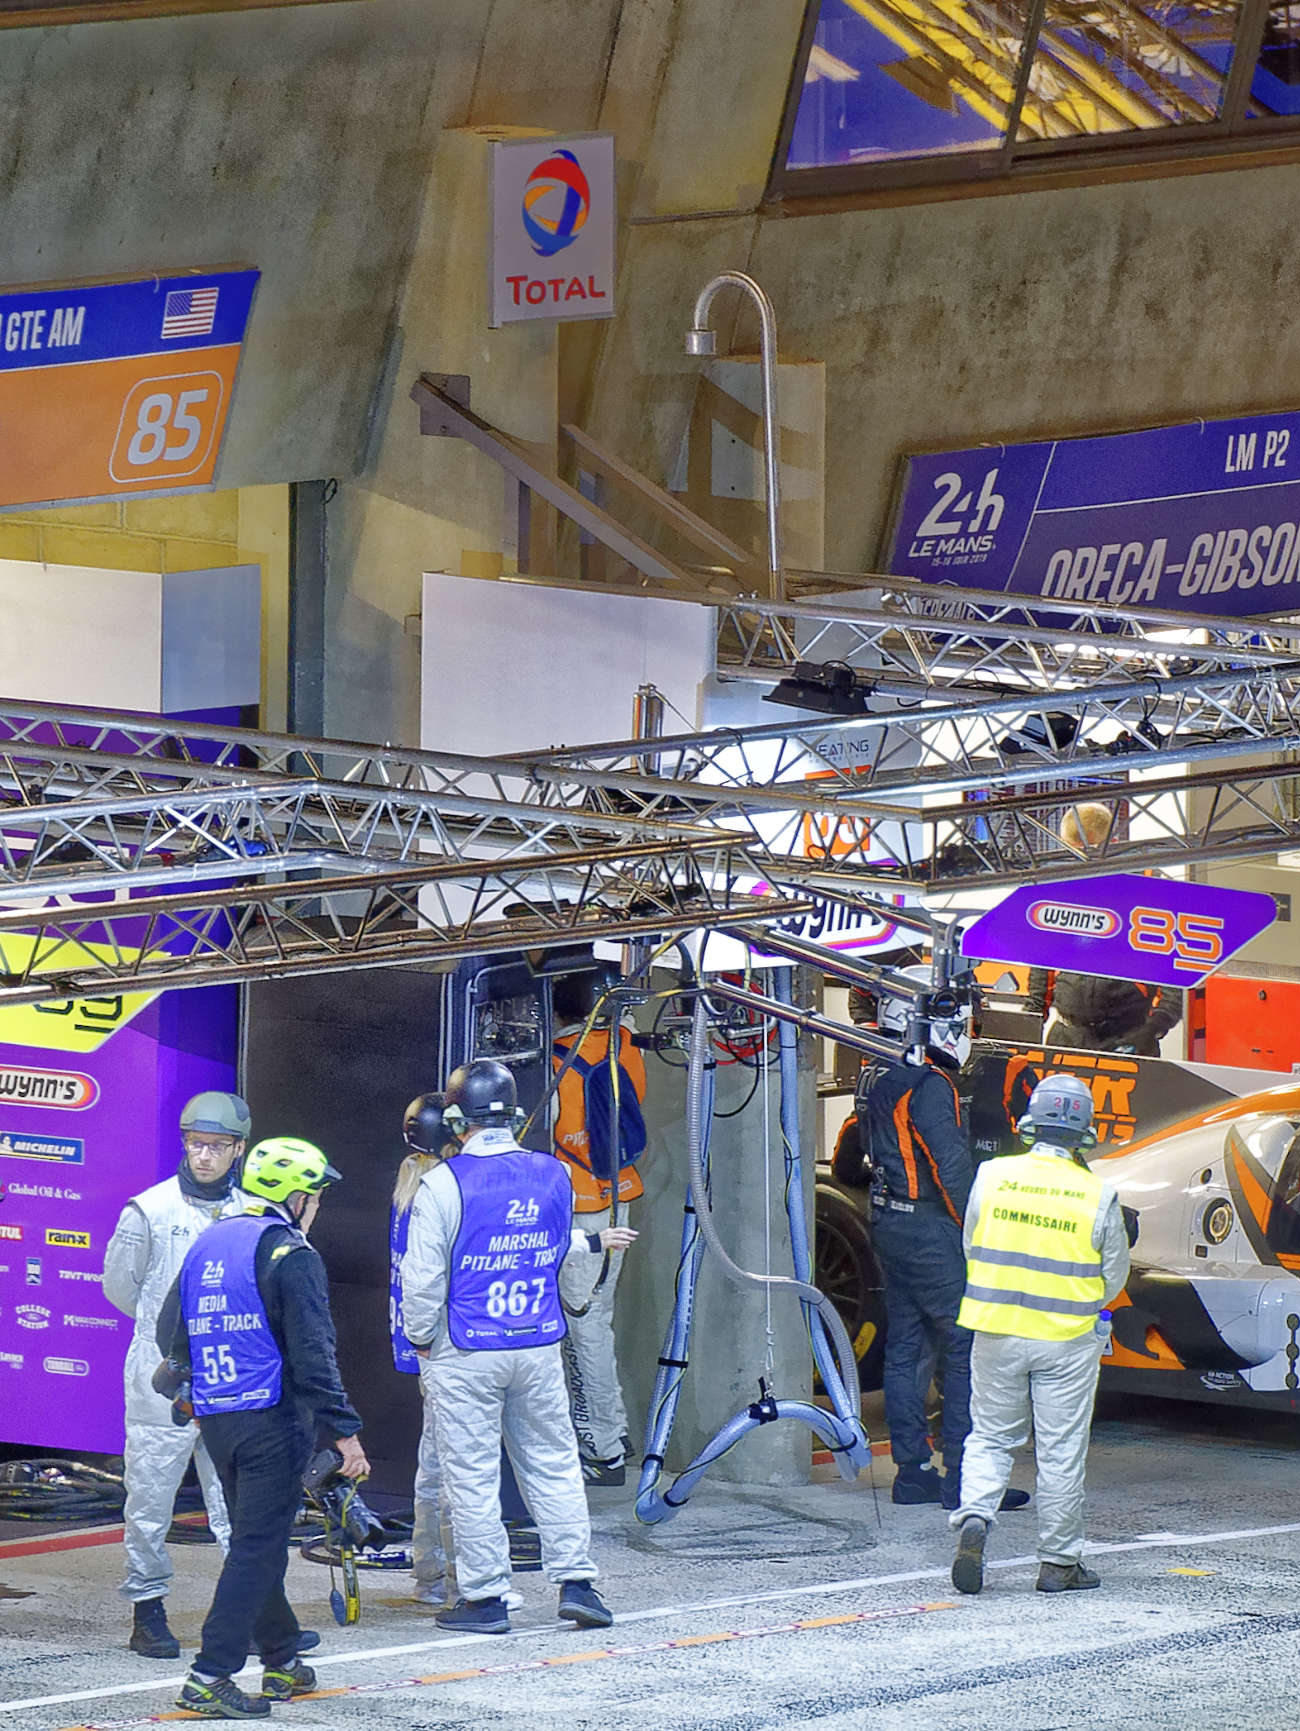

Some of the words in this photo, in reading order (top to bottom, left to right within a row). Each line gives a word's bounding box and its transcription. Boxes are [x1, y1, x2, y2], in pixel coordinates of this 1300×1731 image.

[506, 275, 606, 305] TOTAL
[5, 309, 47, 352] GTE
[47, 306, 86, 348] AM
[127, 389, 209, 466] 85
[1225, 433, 1256, 473] LM
[1263, 429, 1291, 469] P2
[908, 540, 937, 558] LE
[935, 534, 994, 555] MANS
[808, 740, 869, 758] EATING
[1128, 905, 1225, 963] 85
[14, 1141, 77, 1157] MICHELIN
[8, 1183, 37, 1198] Global
[38, 1185, 53, 1199] Oil
[64, 1189, 82, 1201] Gas
[0, 1226, 22, 1240] TUL
[993, 1207, 1079, 1234] COMMISSAIRE
[488, 1230, 549, 1253] MARSHAL
[460, 1254, 520, 1272] PITLANE
[486, 1277, 547, 1319] 867
[222, 1312, 263, 1332] TRACK
[201, 1344, 238, 1386] 55
